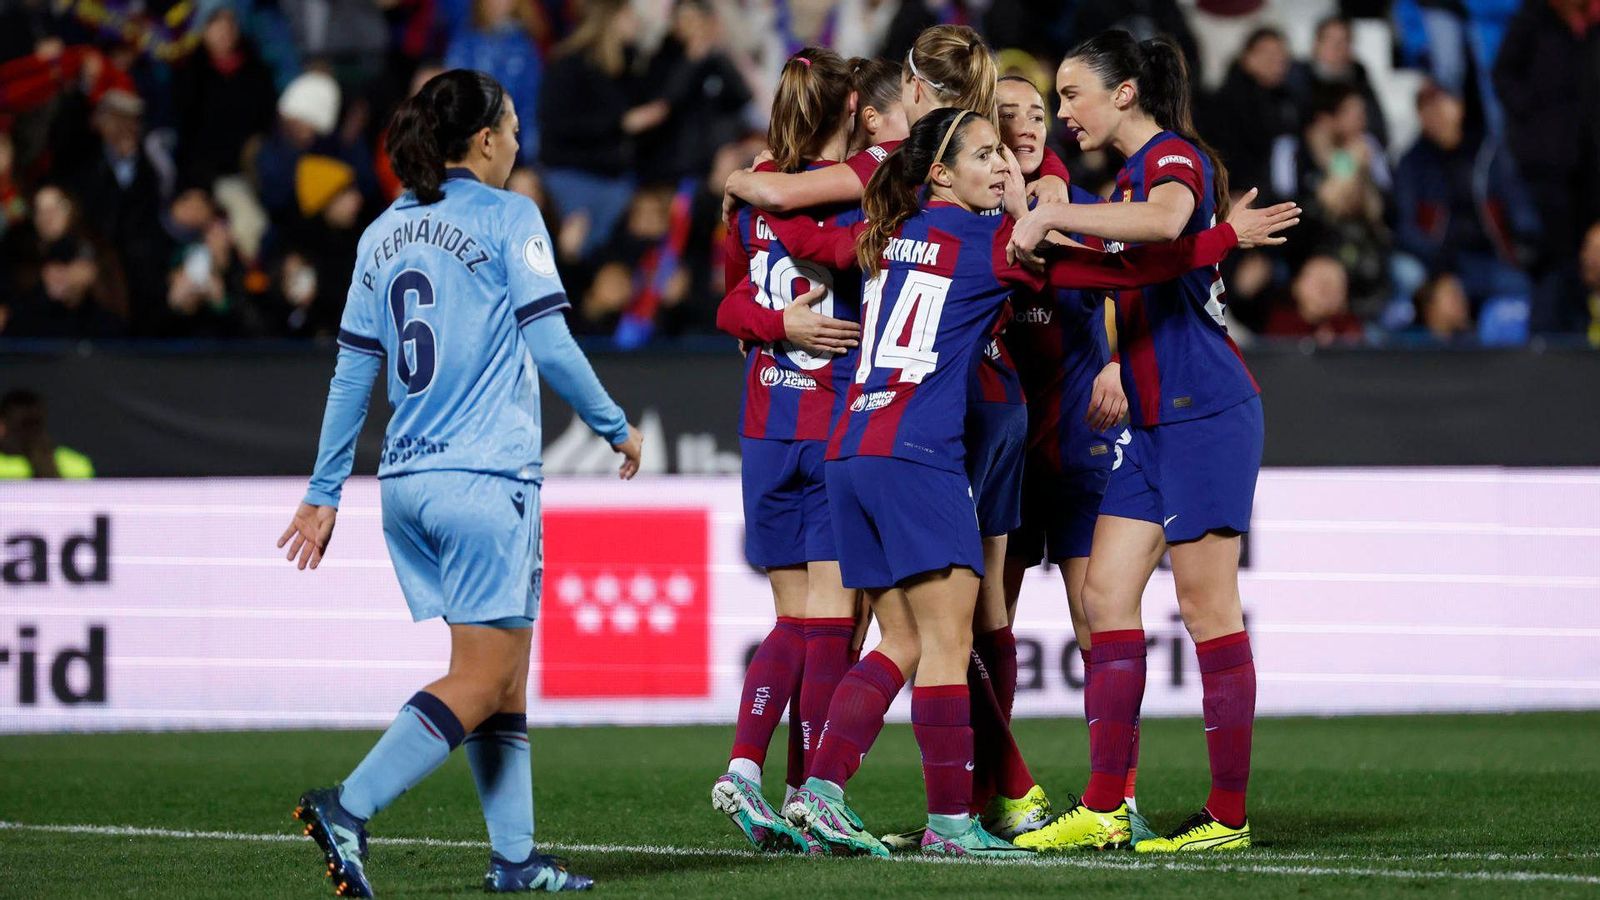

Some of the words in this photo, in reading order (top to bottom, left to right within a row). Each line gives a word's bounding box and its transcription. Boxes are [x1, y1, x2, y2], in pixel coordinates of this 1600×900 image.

[362, 268, 377, 292] P.
[374, 212, 490, 275] FERNÁNDEZ
[388, 267, 437, 398] 6
[856, 269, 954, 385] 14
[1015, 307, 1053, 325] otify
[751, 686, 771, 716] BARÇA
[801, 720, 813, 750] BARÇA
